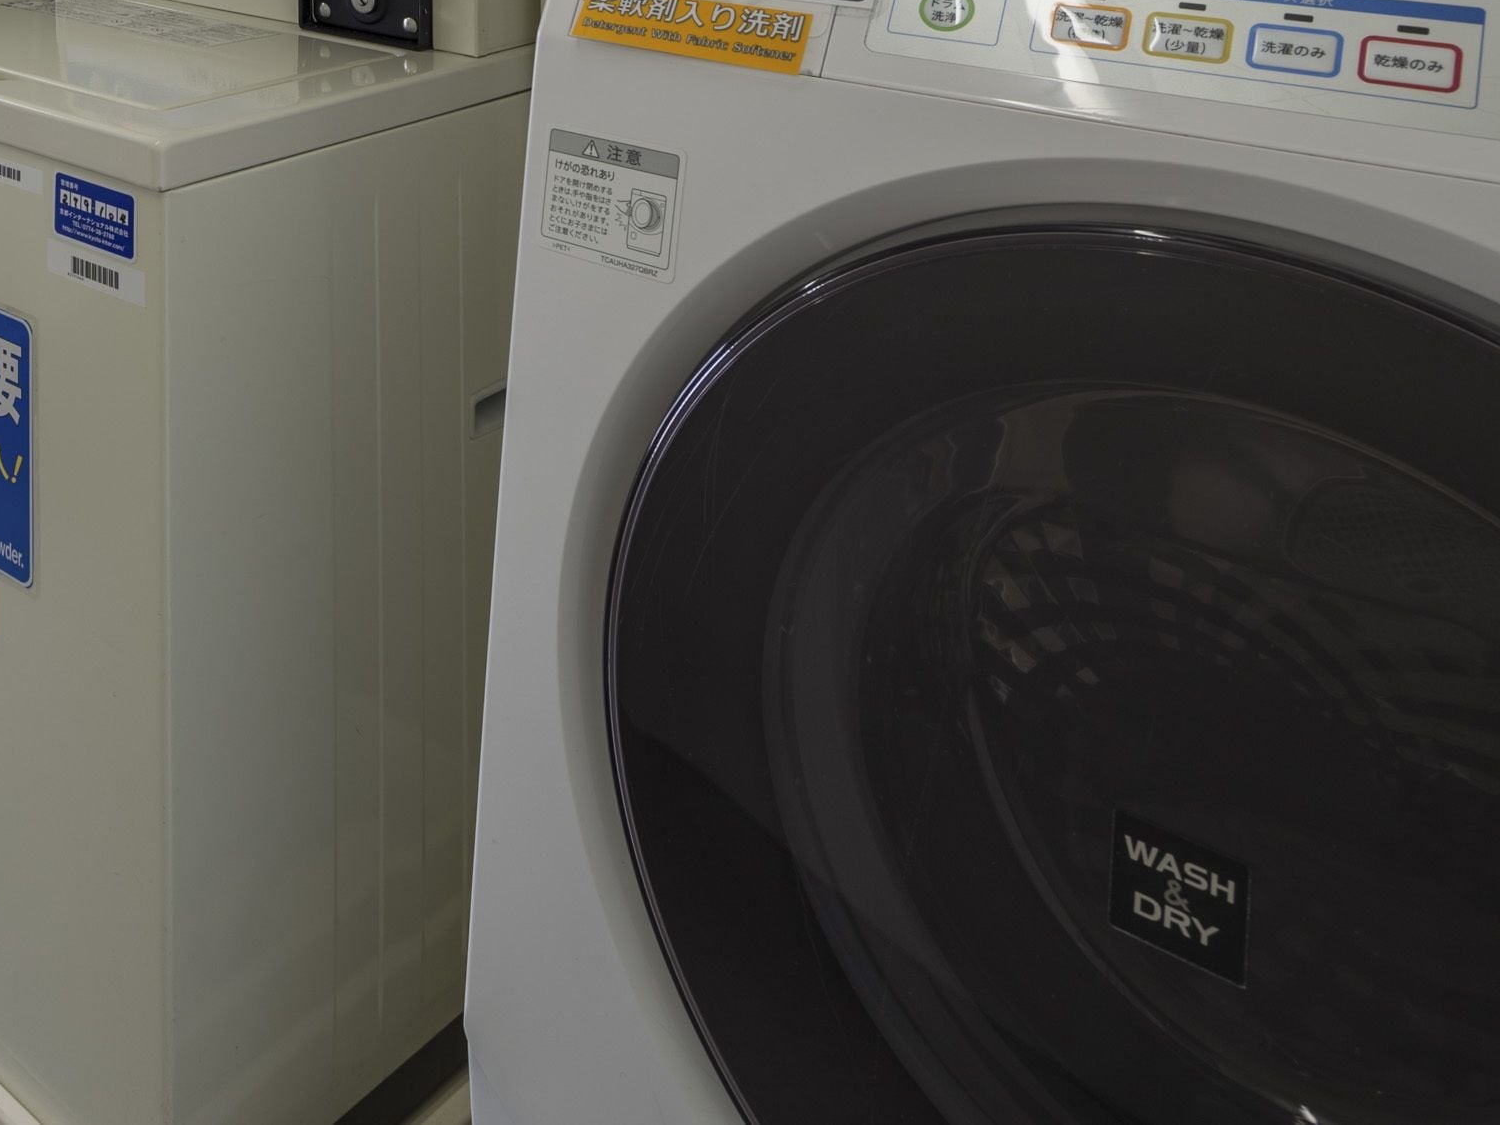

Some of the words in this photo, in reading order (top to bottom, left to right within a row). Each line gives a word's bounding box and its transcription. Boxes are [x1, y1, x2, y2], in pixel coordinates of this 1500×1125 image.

[582, 16, 647, 36] Detergent
[685, 32, 729, 51] Fabric
[732, 41, 796, 62] Softener
[1261, 41, 1327, 59] 洗濯のみ
[1373, 53, 1445, 73] 乾燥のみ
[554, 158, 616, 182] けがの恐れあり
[606, 144, 643, 167] 注意
[1124, 833, 1236, 905] WASH
[1163, 878, 1191, 914] &
[1133, 890, 1220, 947] DRY
